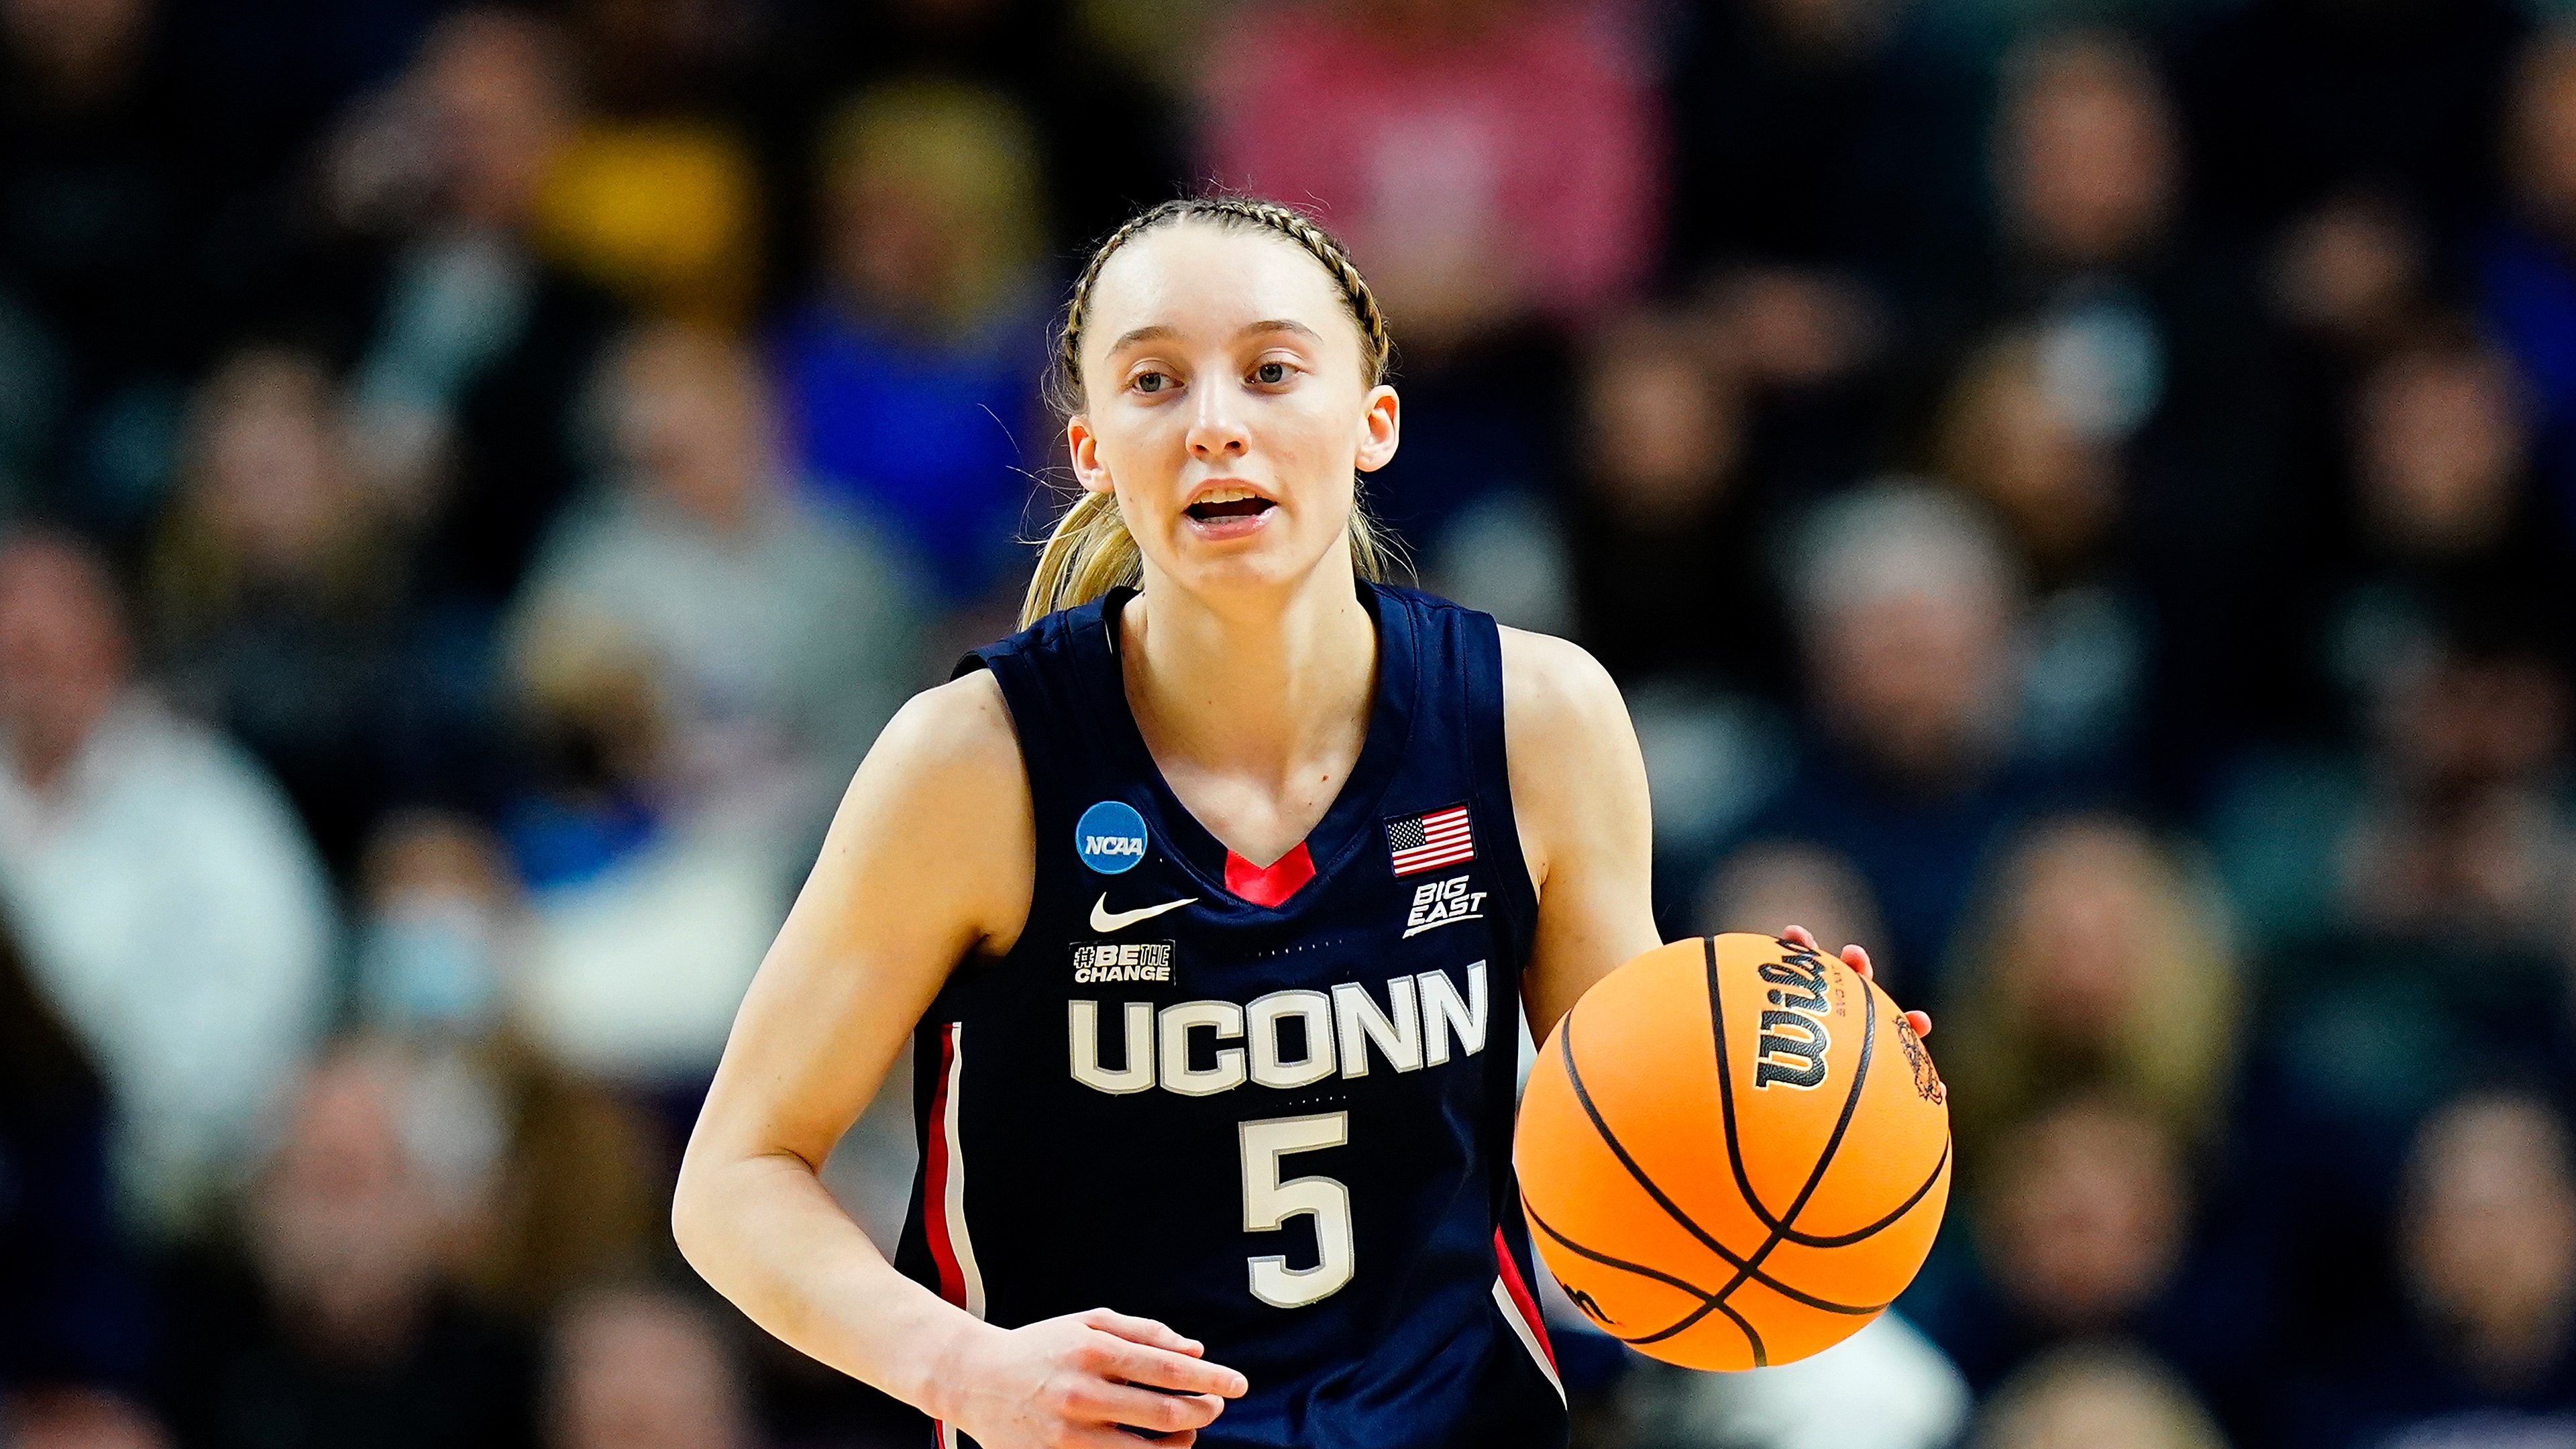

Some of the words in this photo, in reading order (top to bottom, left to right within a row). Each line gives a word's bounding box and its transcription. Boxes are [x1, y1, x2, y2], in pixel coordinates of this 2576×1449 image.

[1085, 835, 1143, 856] NCAA
[1413, 875, 1470, 906] BIG
[1407, 892, 1487, 926] EAST
[1074, 966, 1171, 983] CHANGE
[1068, 959, 1487, 1097] UCONN
[1238, 1110, 1354, 1308] 5
